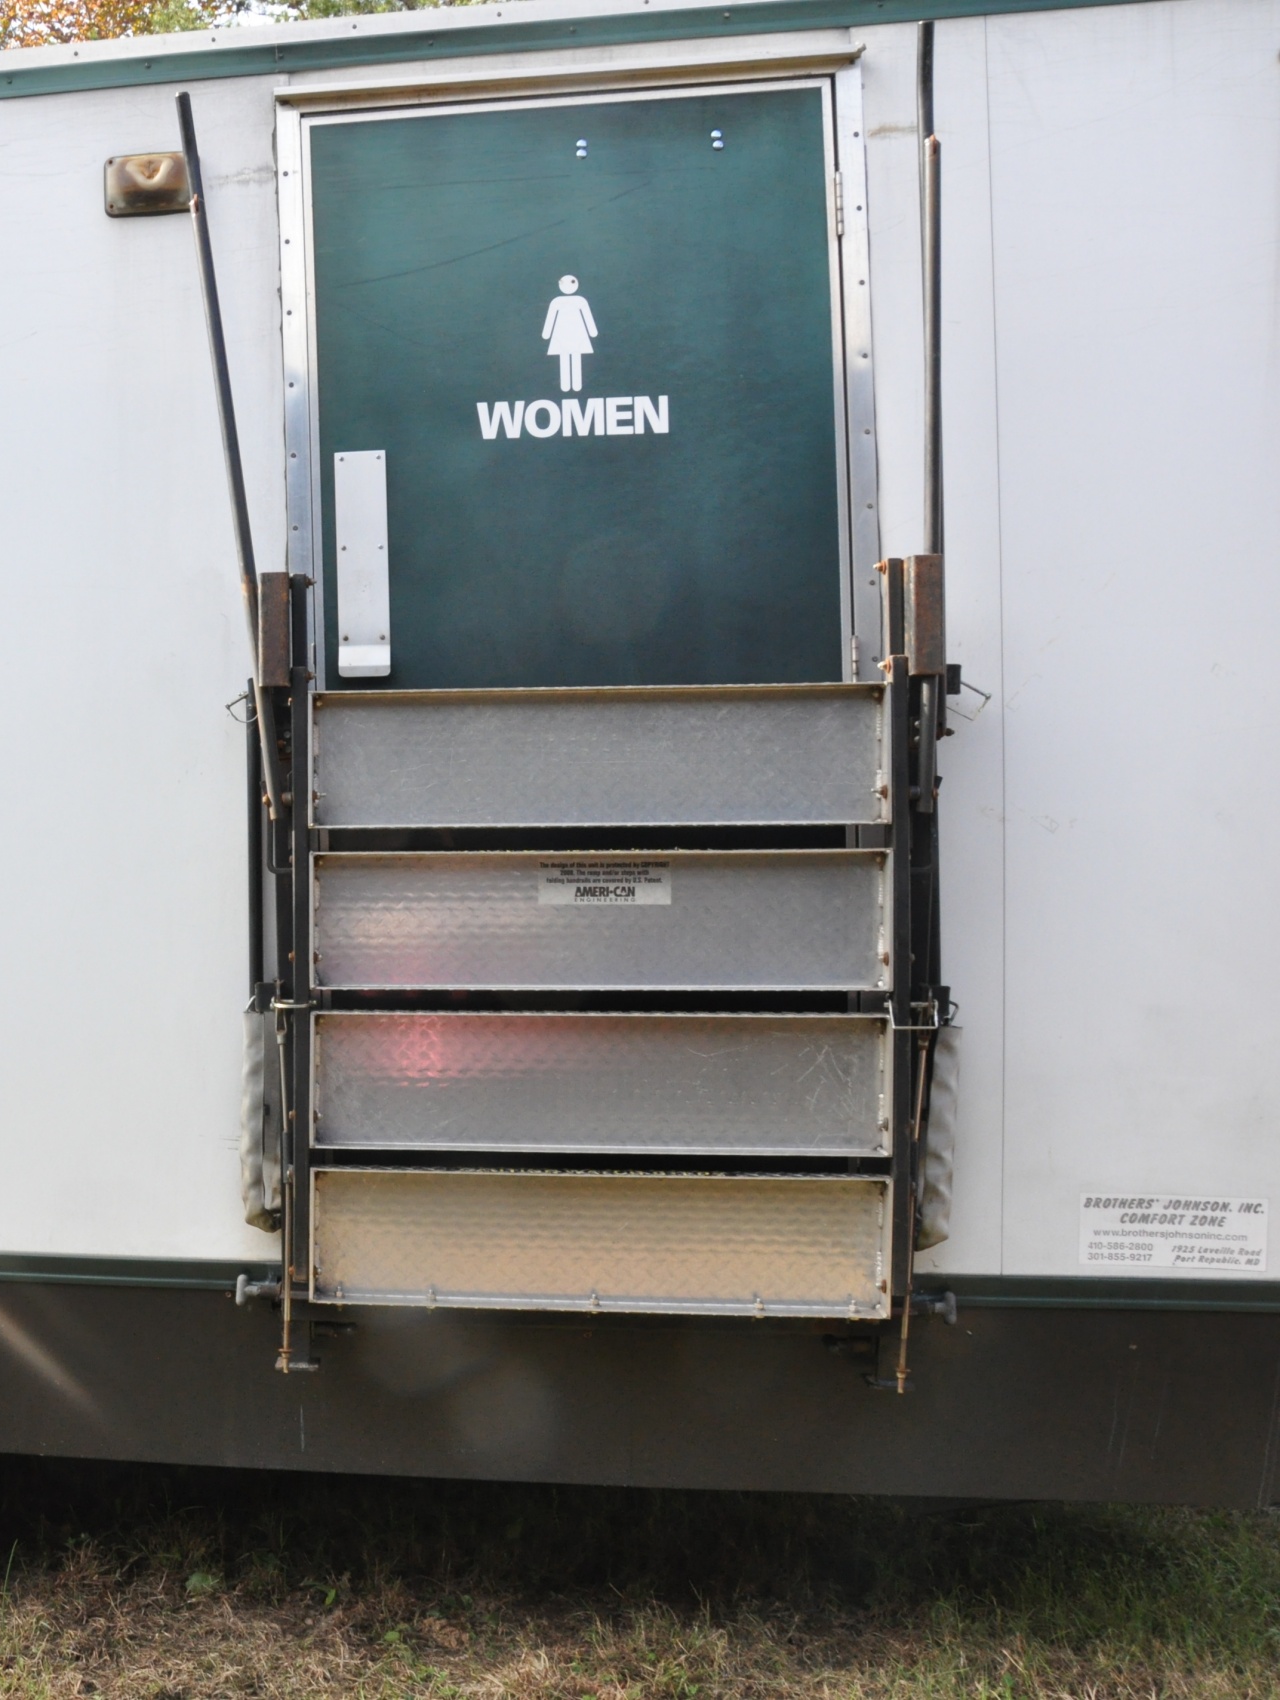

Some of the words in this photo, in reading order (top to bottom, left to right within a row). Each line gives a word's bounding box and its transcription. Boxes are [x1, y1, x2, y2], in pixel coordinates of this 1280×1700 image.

[476, 395, 669, 439] WOMEN
[575, 886, 635, 897] AMERI-CAN
[1083, 1197, 1160, 1209] BROTHERS'
[1237, 1202, 1265, 1214] INC.
[1120, 1212, 1186, 1225] COMFORT
[1189, 1215, 1227, 1228] ZONE
[1093, 1229, 1248, 1241] www.brothersjohnsoninc.com
[1088, 1241, 1154, 1251] 410-586-2800
[1171, 1245, 1195, 1254] 1925
[1237, 1248, 1263, 1257] Road
[1087, 1252, 1153, 1261] 301-855-9217
[1174, 1255, 1196, 1263] Port
[1244, 1258, 1261, 1266] MD
